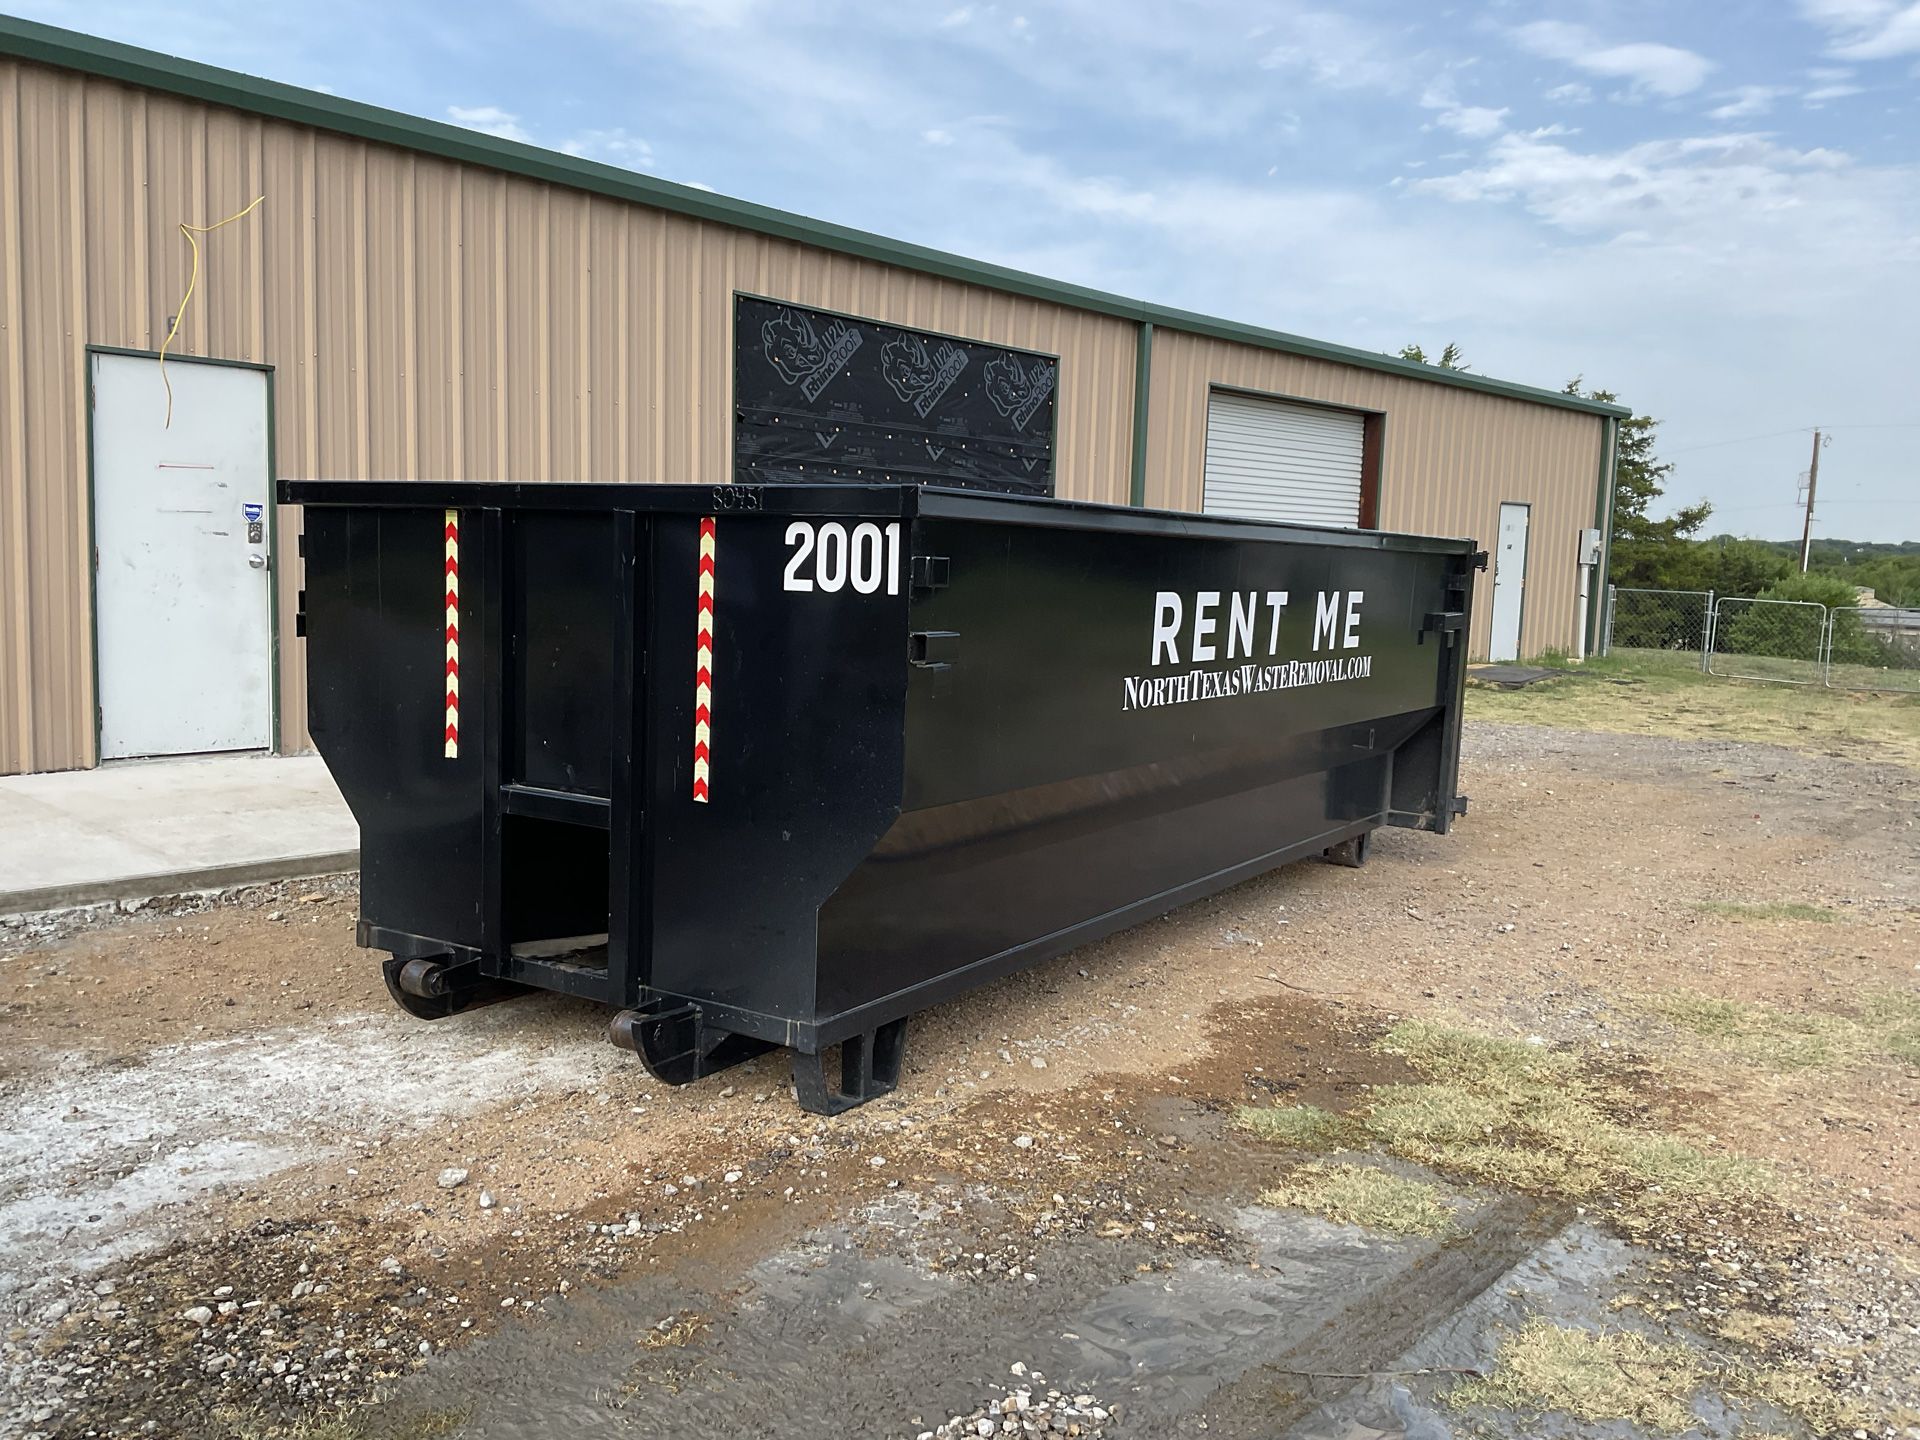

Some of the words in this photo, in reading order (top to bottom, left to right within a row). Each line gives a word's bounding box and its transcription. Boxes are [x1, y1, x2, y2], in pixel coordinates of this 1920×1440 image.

[802, 328, 860, 400] RhinoRoof
[821, 319, 846, 350] U20
[933, 341, 954, 369] U20
[916, 349, 966, 415] RhinoRoof
[784, 521, 899, 595] 2001
[1151, 591, 1288, 665] RENT
[1312, 591, 1363, 651] ME
